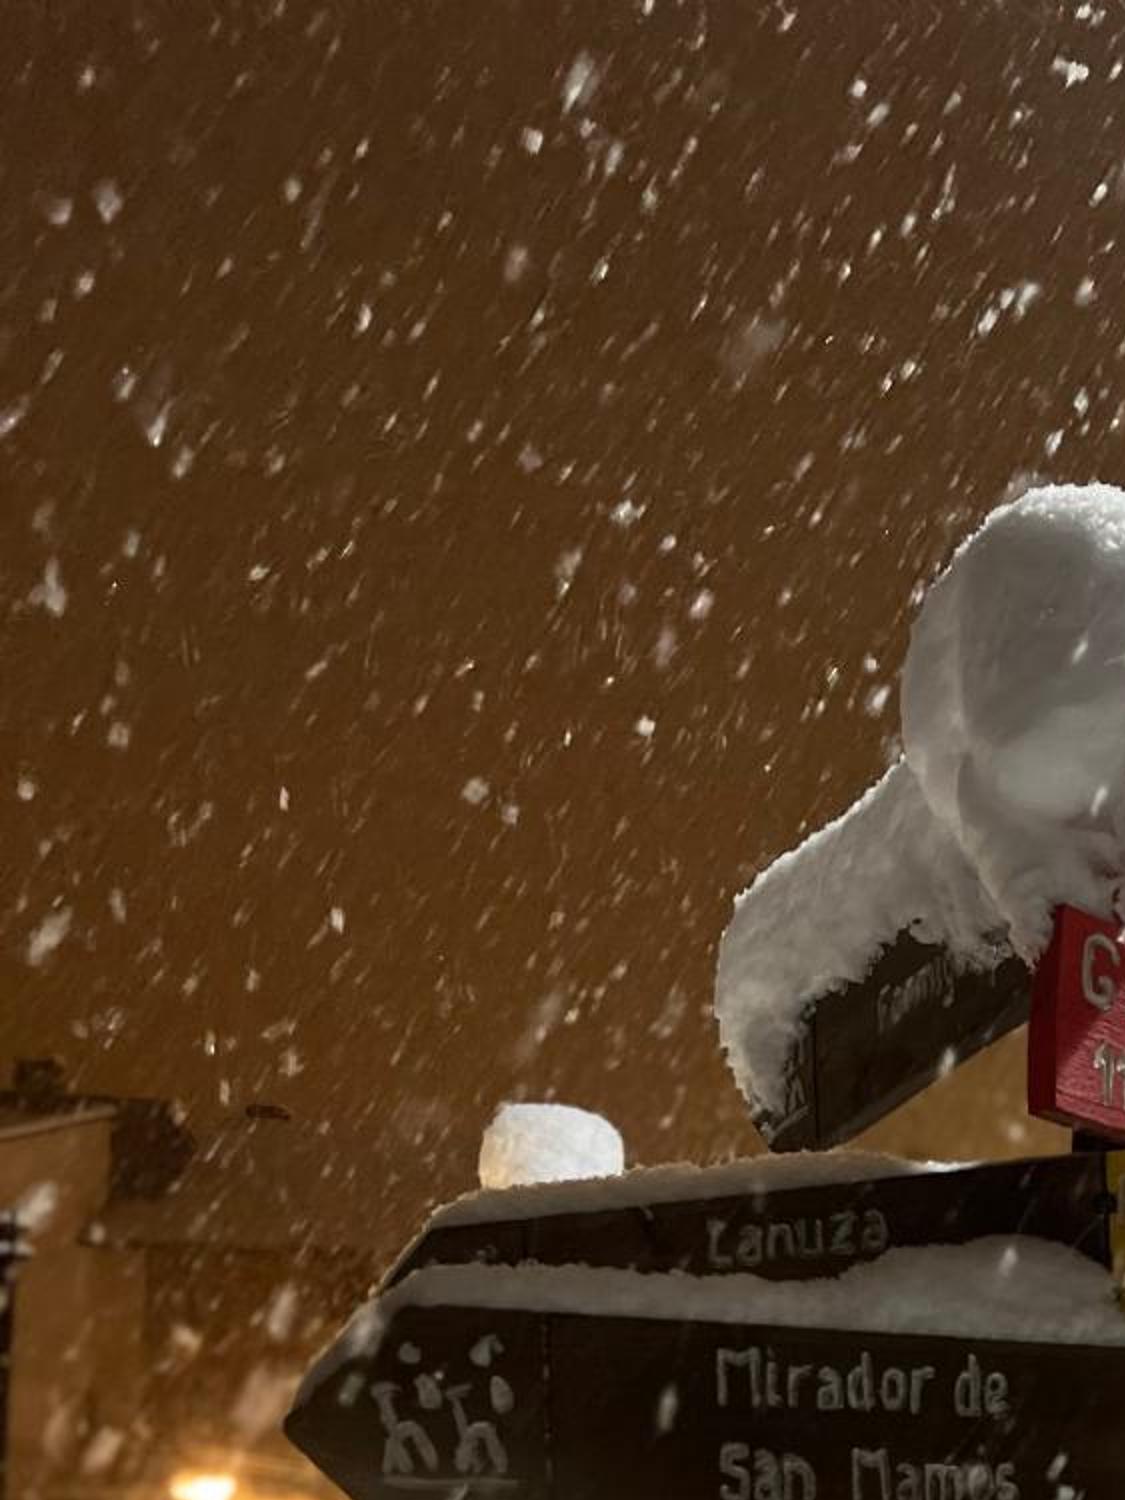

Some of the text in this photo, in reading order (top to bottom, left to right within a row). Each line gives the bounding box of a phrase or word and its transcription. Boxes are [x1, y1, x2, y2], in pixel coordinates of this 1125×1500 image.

[705, 1208, 890, 1266] Lanuza
[715, 1345, 1010, 1419] Mirador de
